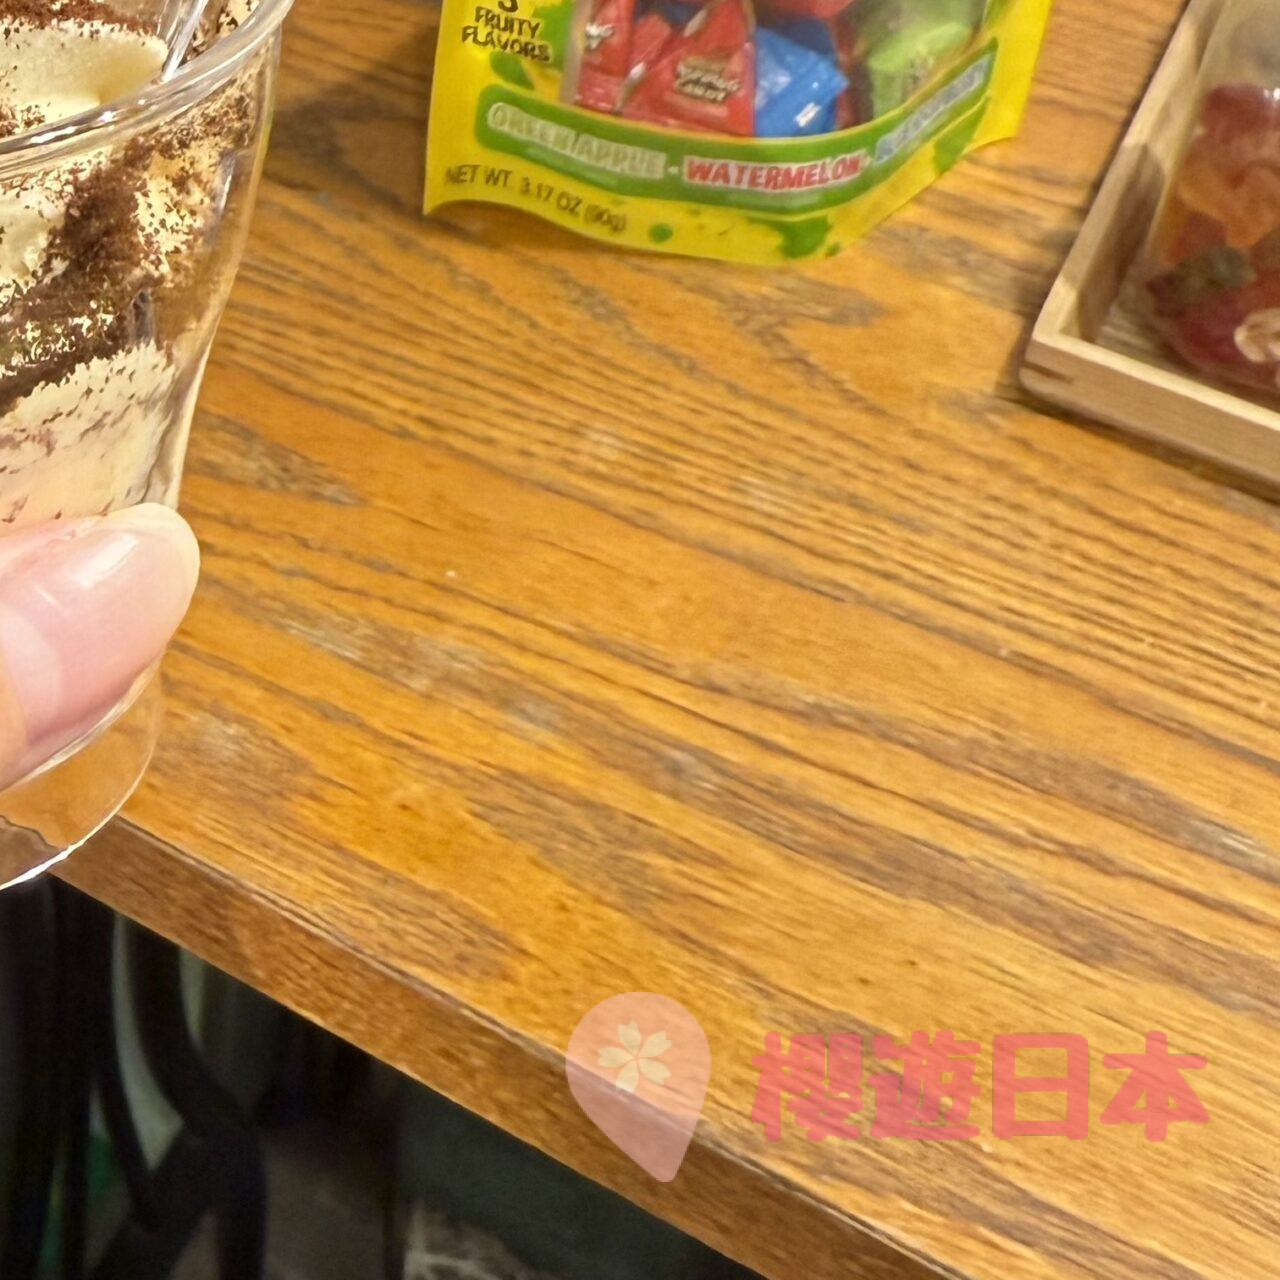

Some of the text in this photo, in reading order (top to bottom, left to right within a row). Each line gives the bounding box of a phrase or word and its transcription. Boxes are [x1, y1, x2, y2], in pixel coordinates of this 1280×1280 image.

[474, 6, 541, 39] FRUITY
[461, 25, 551, 62] FLAVORS
[683, 149, 868, 194] WATERMELON
[556, 191, 583, 217] OZ
